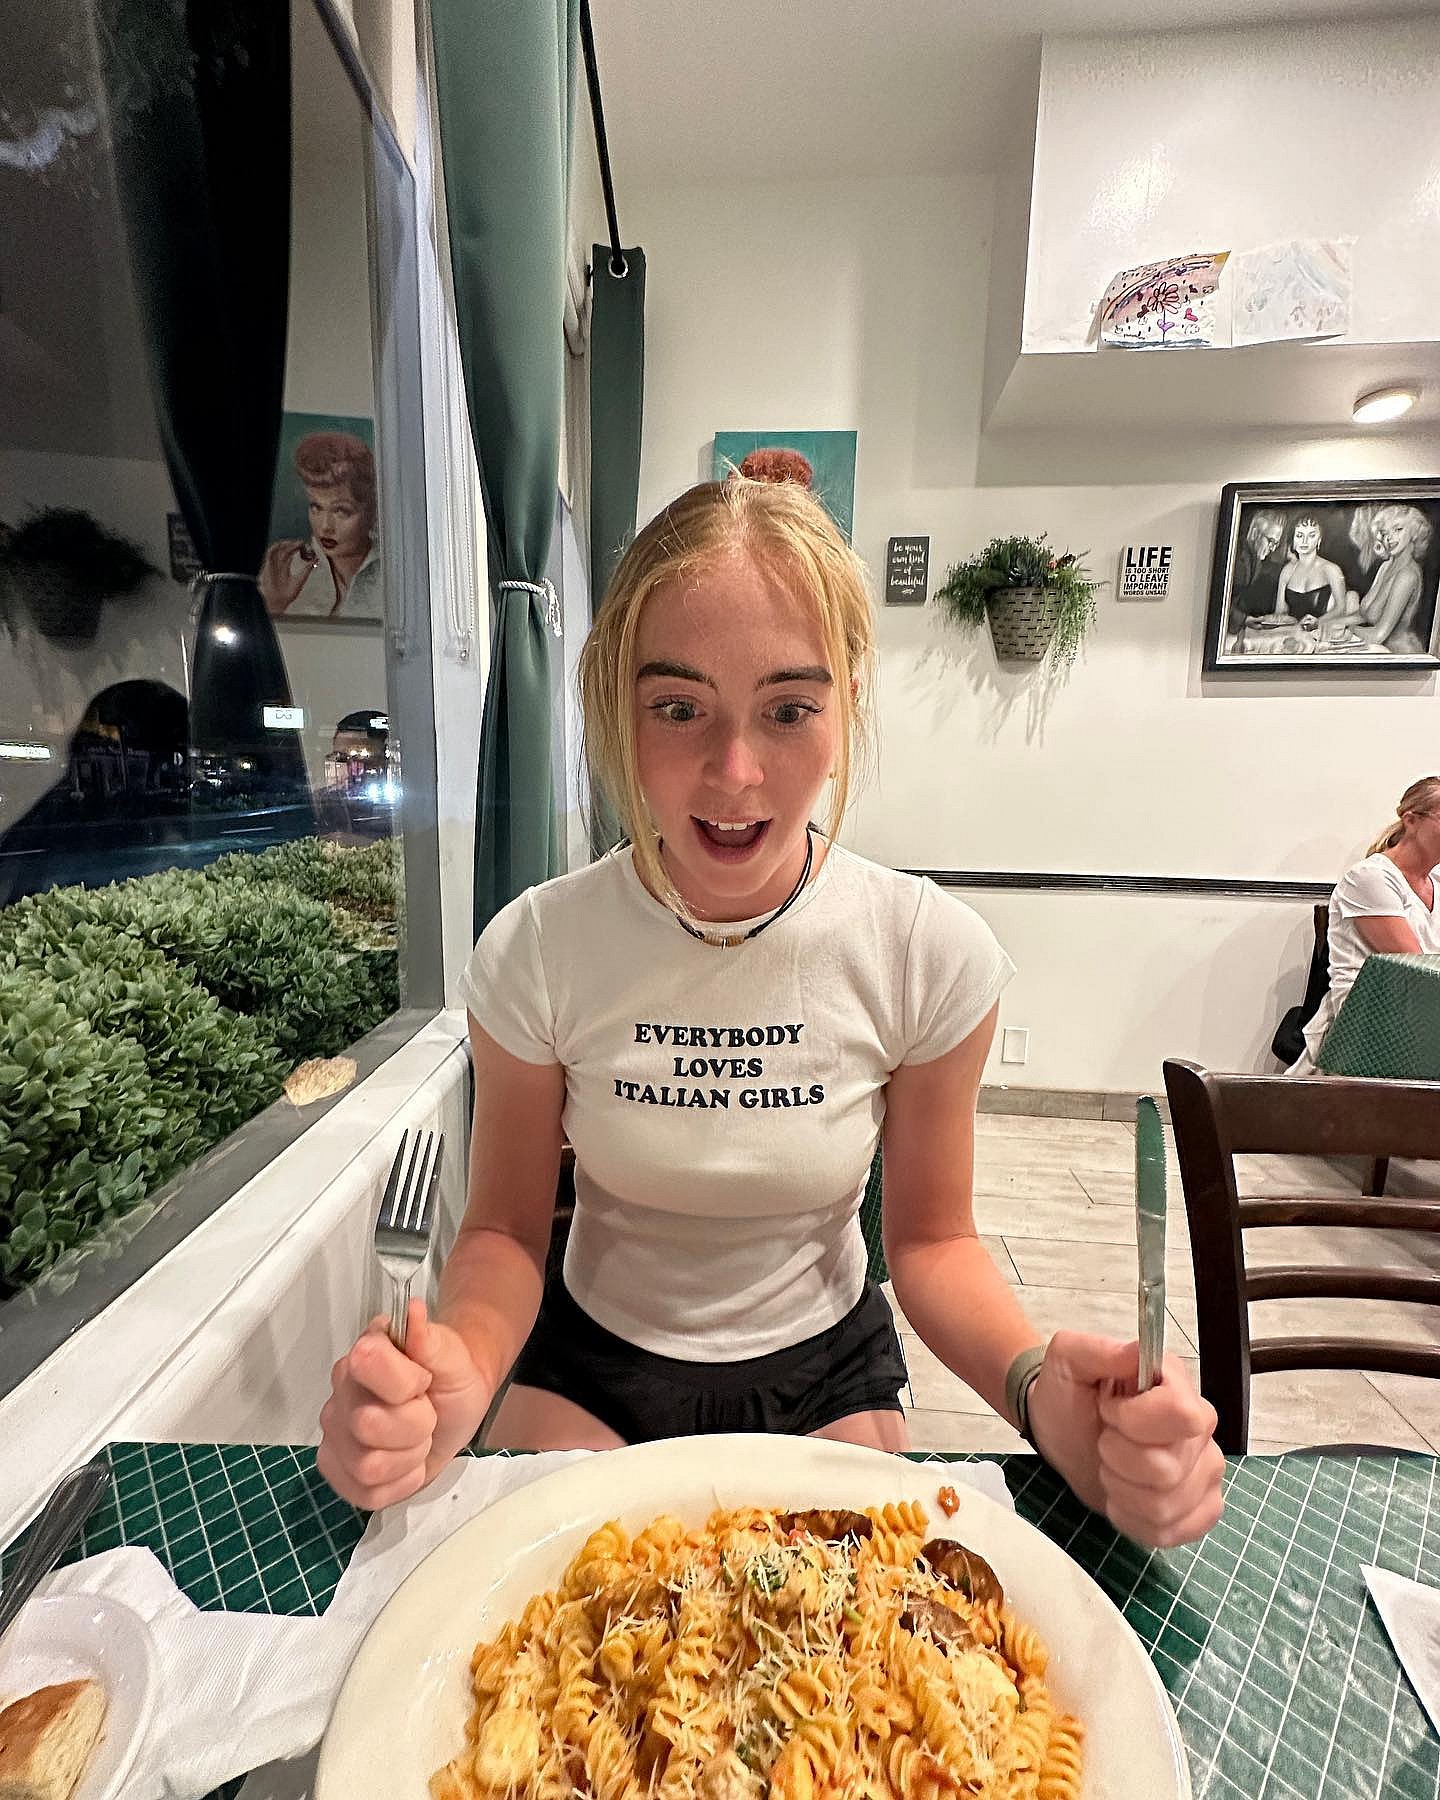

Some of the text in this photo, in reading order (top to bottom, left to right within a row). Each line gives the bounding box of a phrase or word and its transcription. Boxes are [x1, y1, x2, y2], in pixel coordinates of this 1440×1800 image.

[894, 541, 923, 555] be your
[1126, 546, 1172, 567] LIFE
[903, 566, 911, 575] of
[1125, 574, 1169, 582] TO LEAVE
[890, 572, 925, 588] beautiful
[634, 1023, 804, 1047] EVERYBODY
[673, 1057, 763, 1078] LOVES
[614, 1079, 825, 1109] ITALIAN GIRLS
